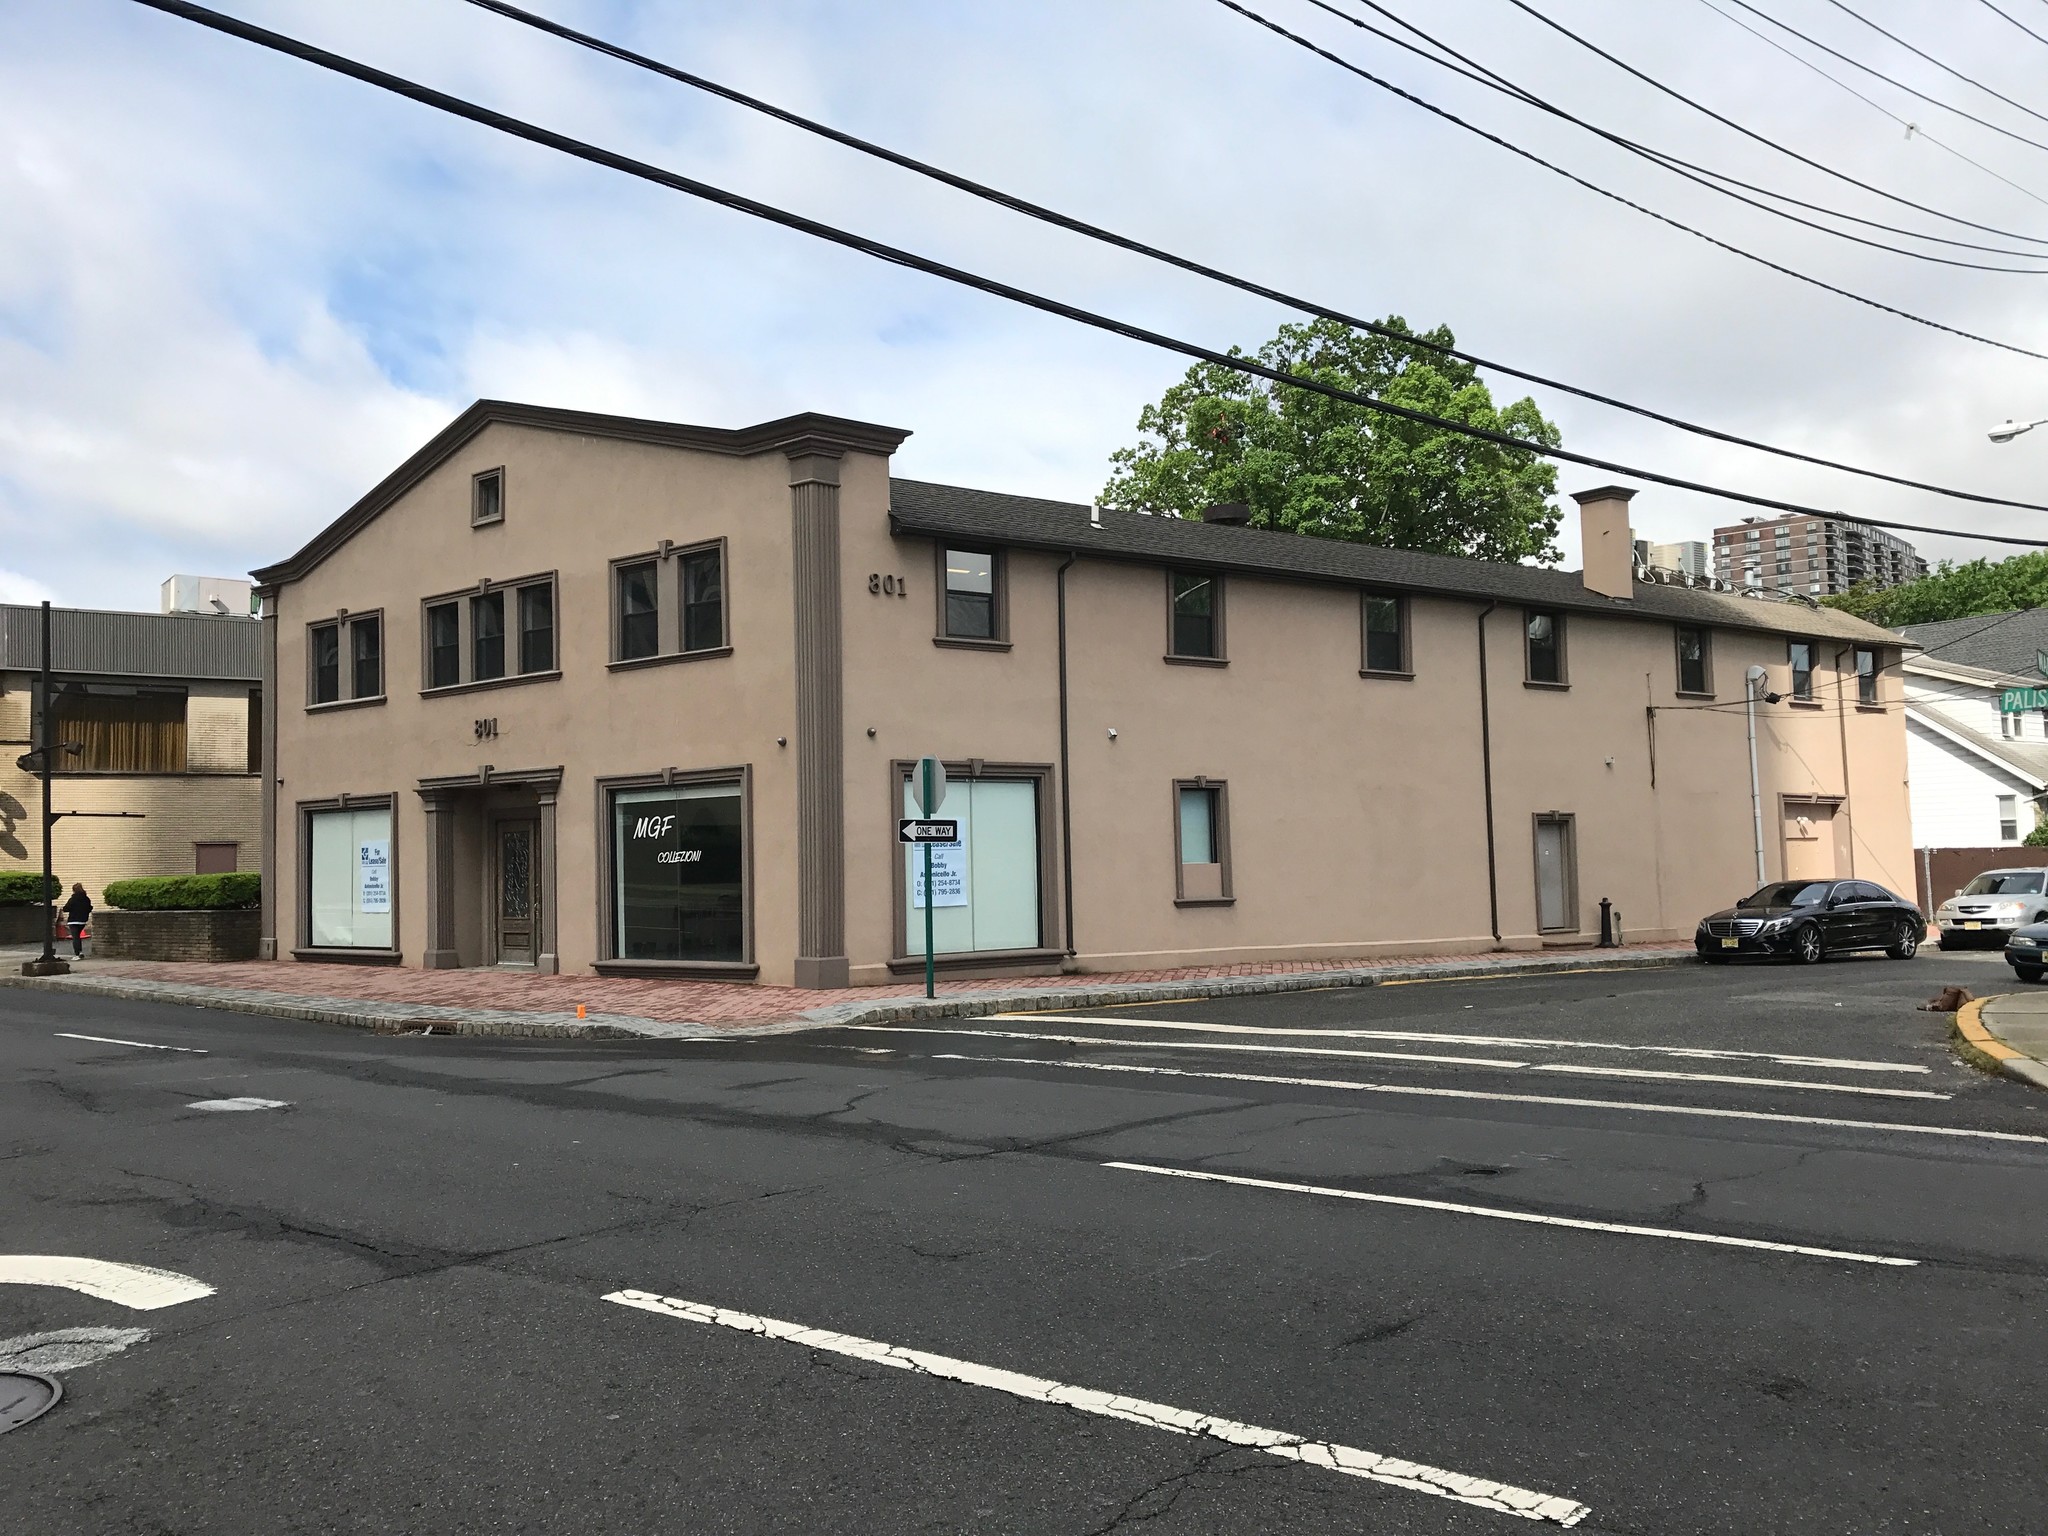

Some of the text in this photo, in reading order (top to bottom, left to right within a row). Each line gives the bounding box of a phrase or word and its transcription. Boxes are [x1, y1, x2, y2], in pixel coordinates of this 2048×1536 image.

[868, 573, 907, 597] 801
[475, 717, 499, 739] 801
[633, 814, 676, 840] MGF
[917, 826, 951, 835] ONE WAY
[657, 850, 702, 863] COLLEZIONI
